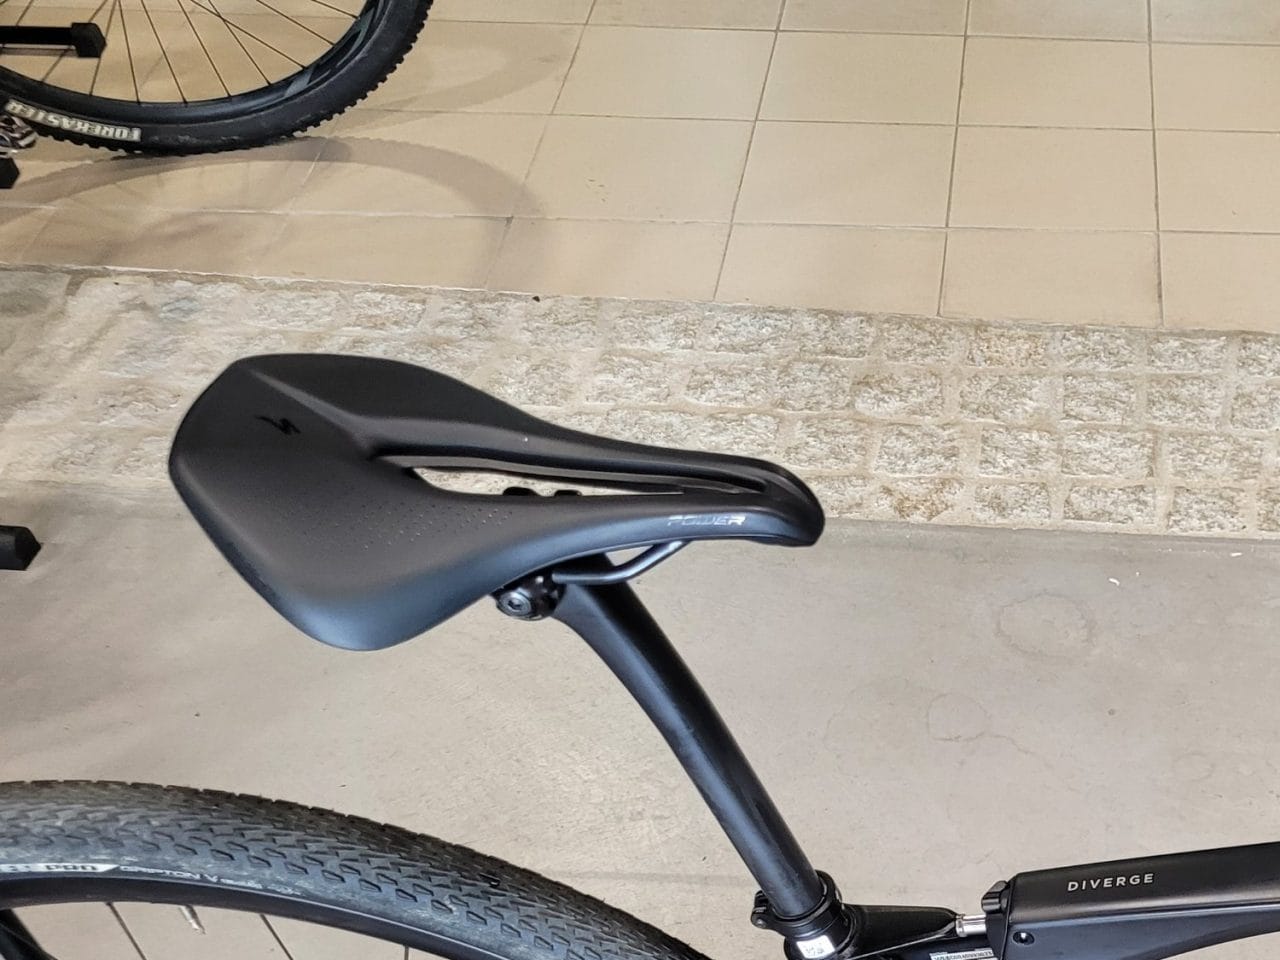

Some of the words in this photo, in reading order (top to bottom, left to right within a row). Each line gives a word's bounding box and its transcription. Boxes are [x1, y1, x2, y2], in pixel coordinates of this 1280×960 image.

[4, 98, 142, 142] FOREKASTER
[667, 513, 747, 526] POWER
[1067, 873, 1155, 892] DIVERGE
